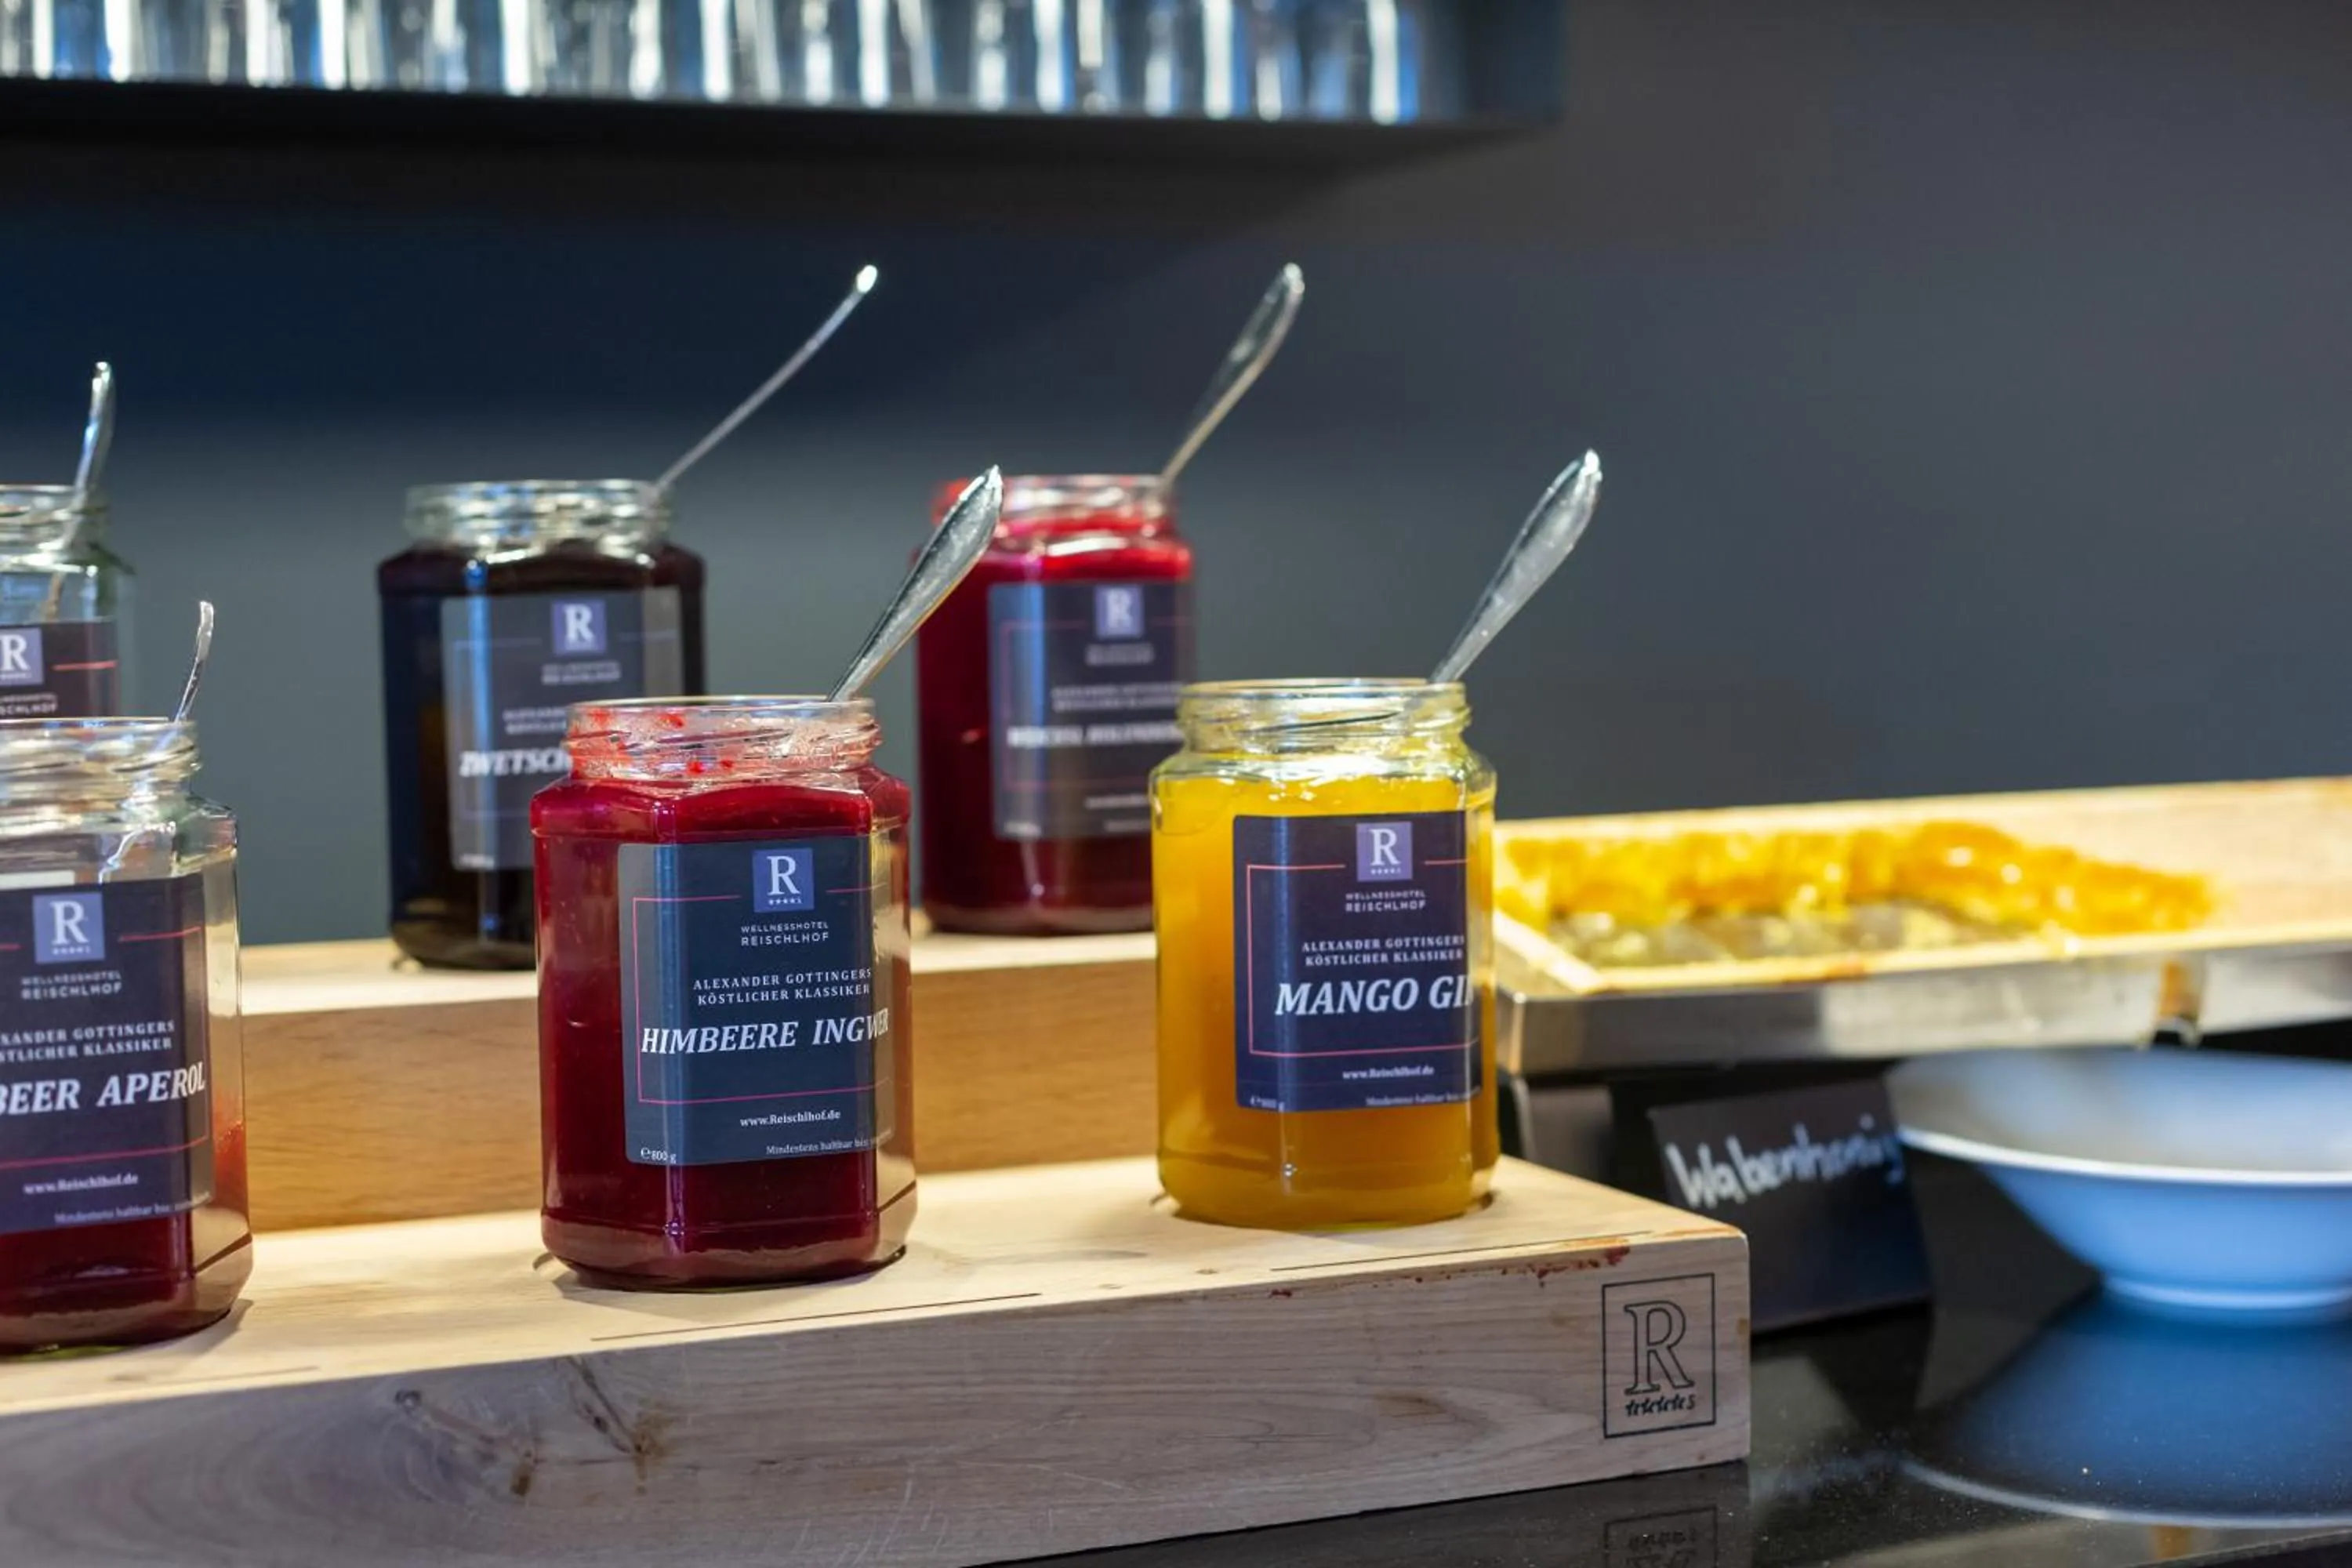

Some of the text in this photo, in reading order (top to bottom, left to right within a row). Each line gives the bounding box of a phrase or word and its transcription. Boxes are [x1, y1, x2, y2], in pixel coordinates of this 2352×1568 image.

[562, 603, 595, 644] R
[1369, 828, 1401, 866] R
[767, 855, 800, 895] R
[50, 900, 89, 946] R
[741, 921, 829, 934] WELLNESSHOTEL
[741, 931, 829, 946] REISCHLHOF
[1302, 938, 1381, 953] ALEXANDER
[1305, 951, 1388, 967] KÖSTLICHER
[693, 974, 780, 991] ALEXANDER
[697, 983, 870, 1007] KÖSTLICHER KLASSIKER
[1274, 978, 1420, 1016] MANGO
[72, 1020, 175, 1040] GOTTINGERS
[641, 1007, 889, 1055] HIMBEERE INGWER
[83, 1036, 172, 1057] KLASSIKER
[96, 1061, 206, 1107] APEROL
[739, 1109, 841, 1127] www.Reischlhof.de
[1624, 1300, 1696, 1396] R
